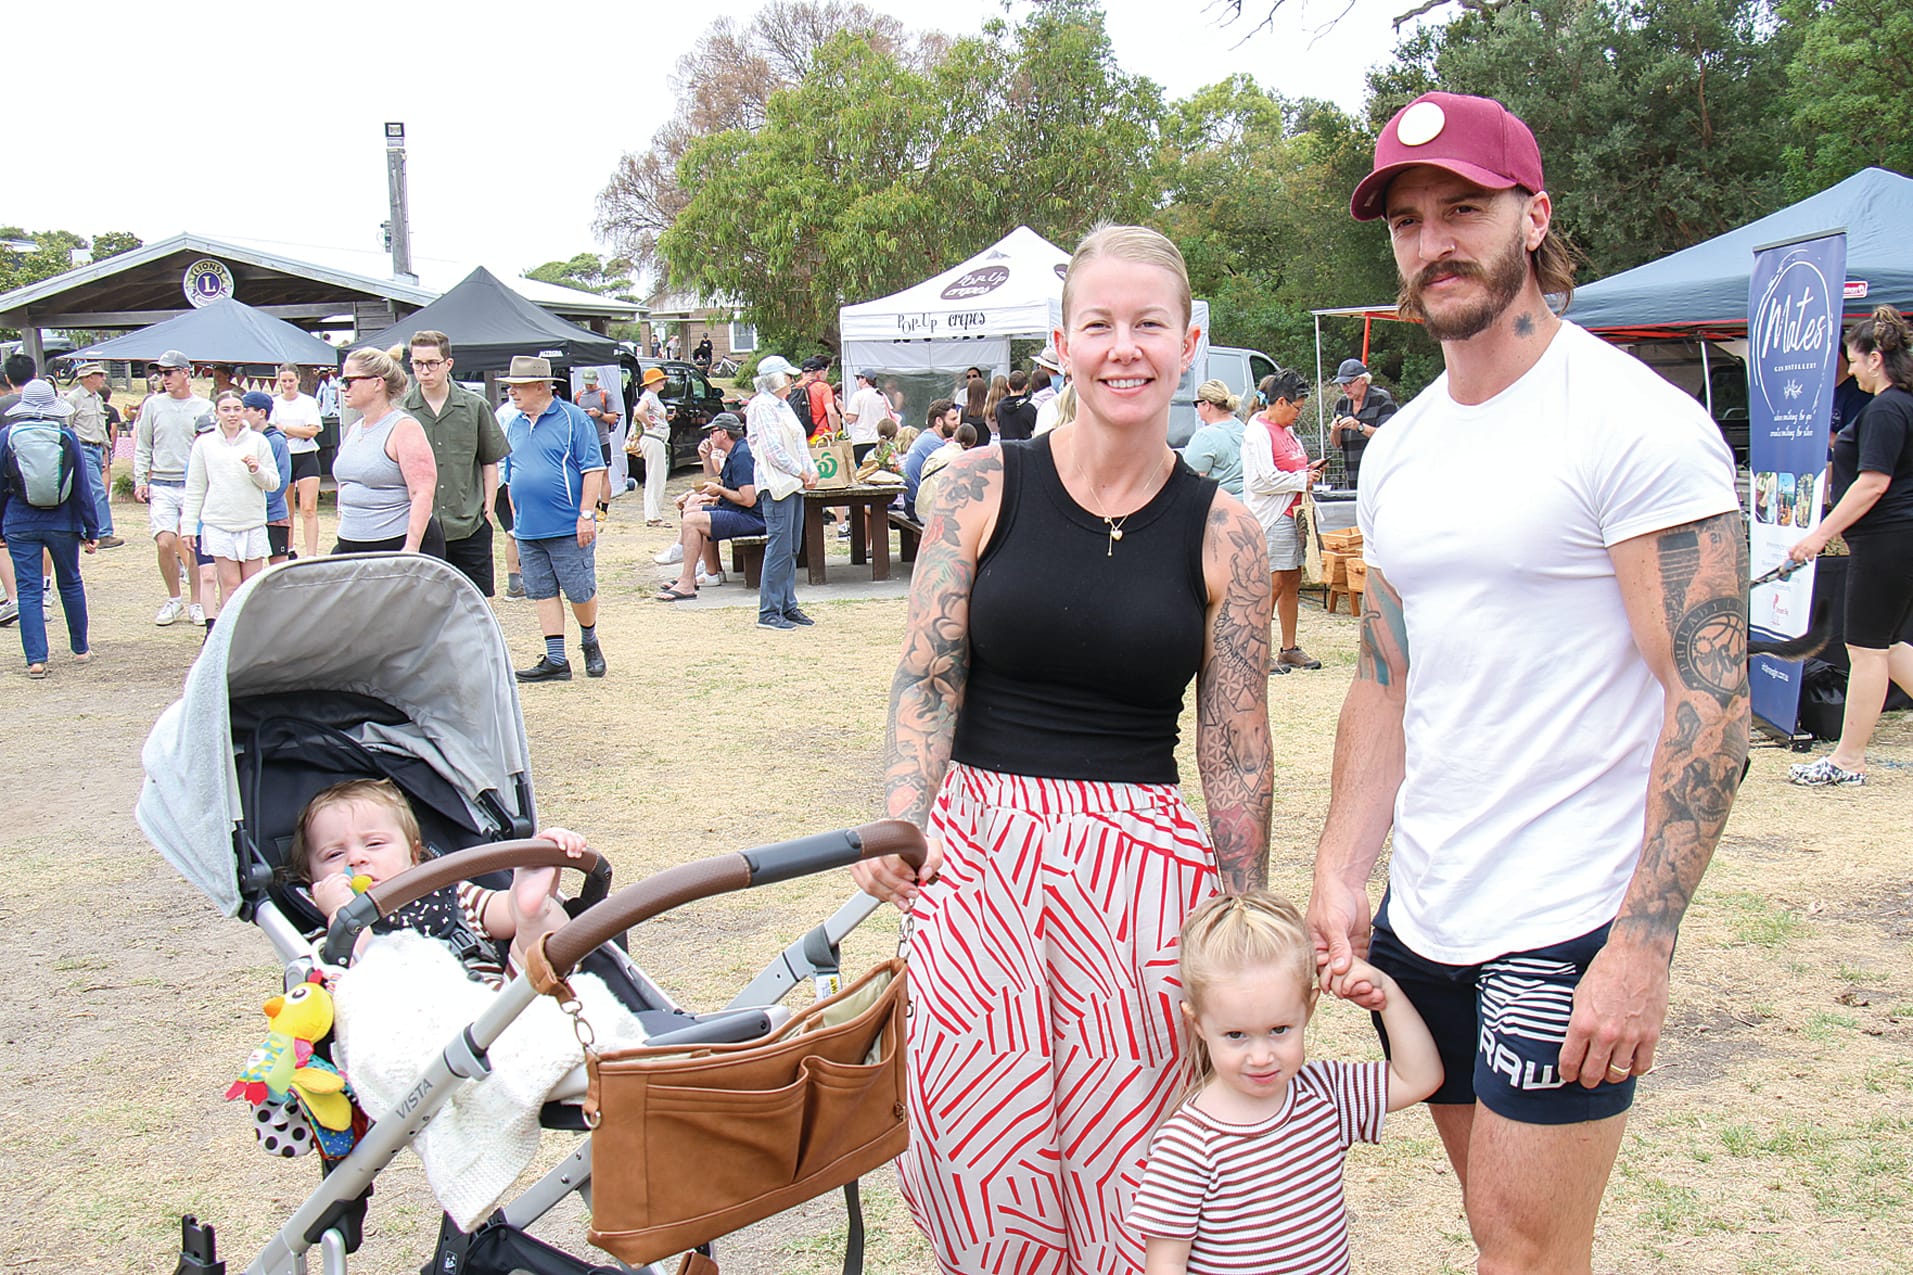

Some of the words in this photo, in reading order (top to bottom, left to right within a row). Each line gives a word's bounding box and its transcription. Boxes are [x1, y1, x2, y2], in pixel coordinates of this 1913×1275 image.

[194, 262, 222, 274] LIONS
[203, 275, 217, 293] L
[988, 271, 1007, 286] Up
[948, 311, 986, 331] crepes
[1761, 286, 1827, 359] Mates
[395, 1078, 433, 1119] VISTA
